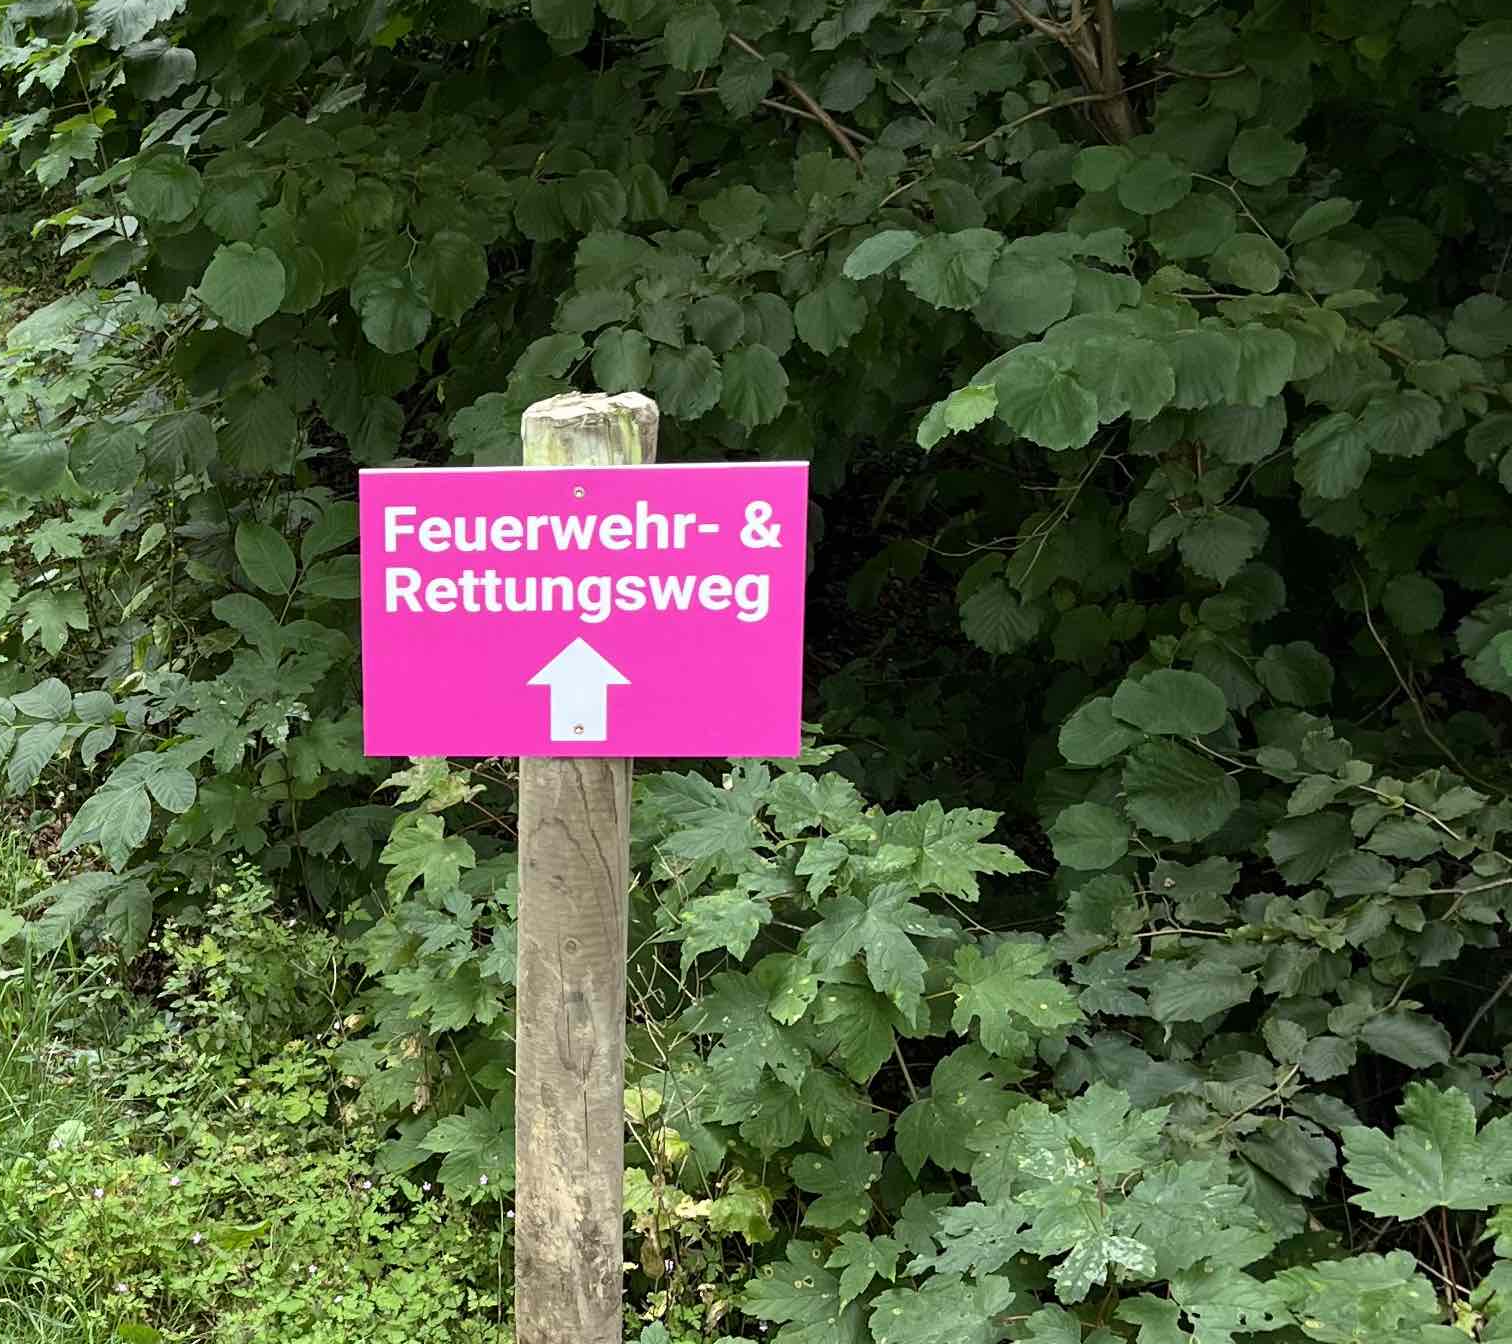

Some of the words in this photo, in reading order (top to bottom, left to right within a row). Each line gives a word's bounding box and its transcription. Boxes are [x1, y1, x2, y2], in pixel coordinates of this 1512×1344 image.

[384, 501, 720, 553] Feuerwehr-
[739, 500, 783, 549] &
[385, 567, 770, 624] Rettungsweg
